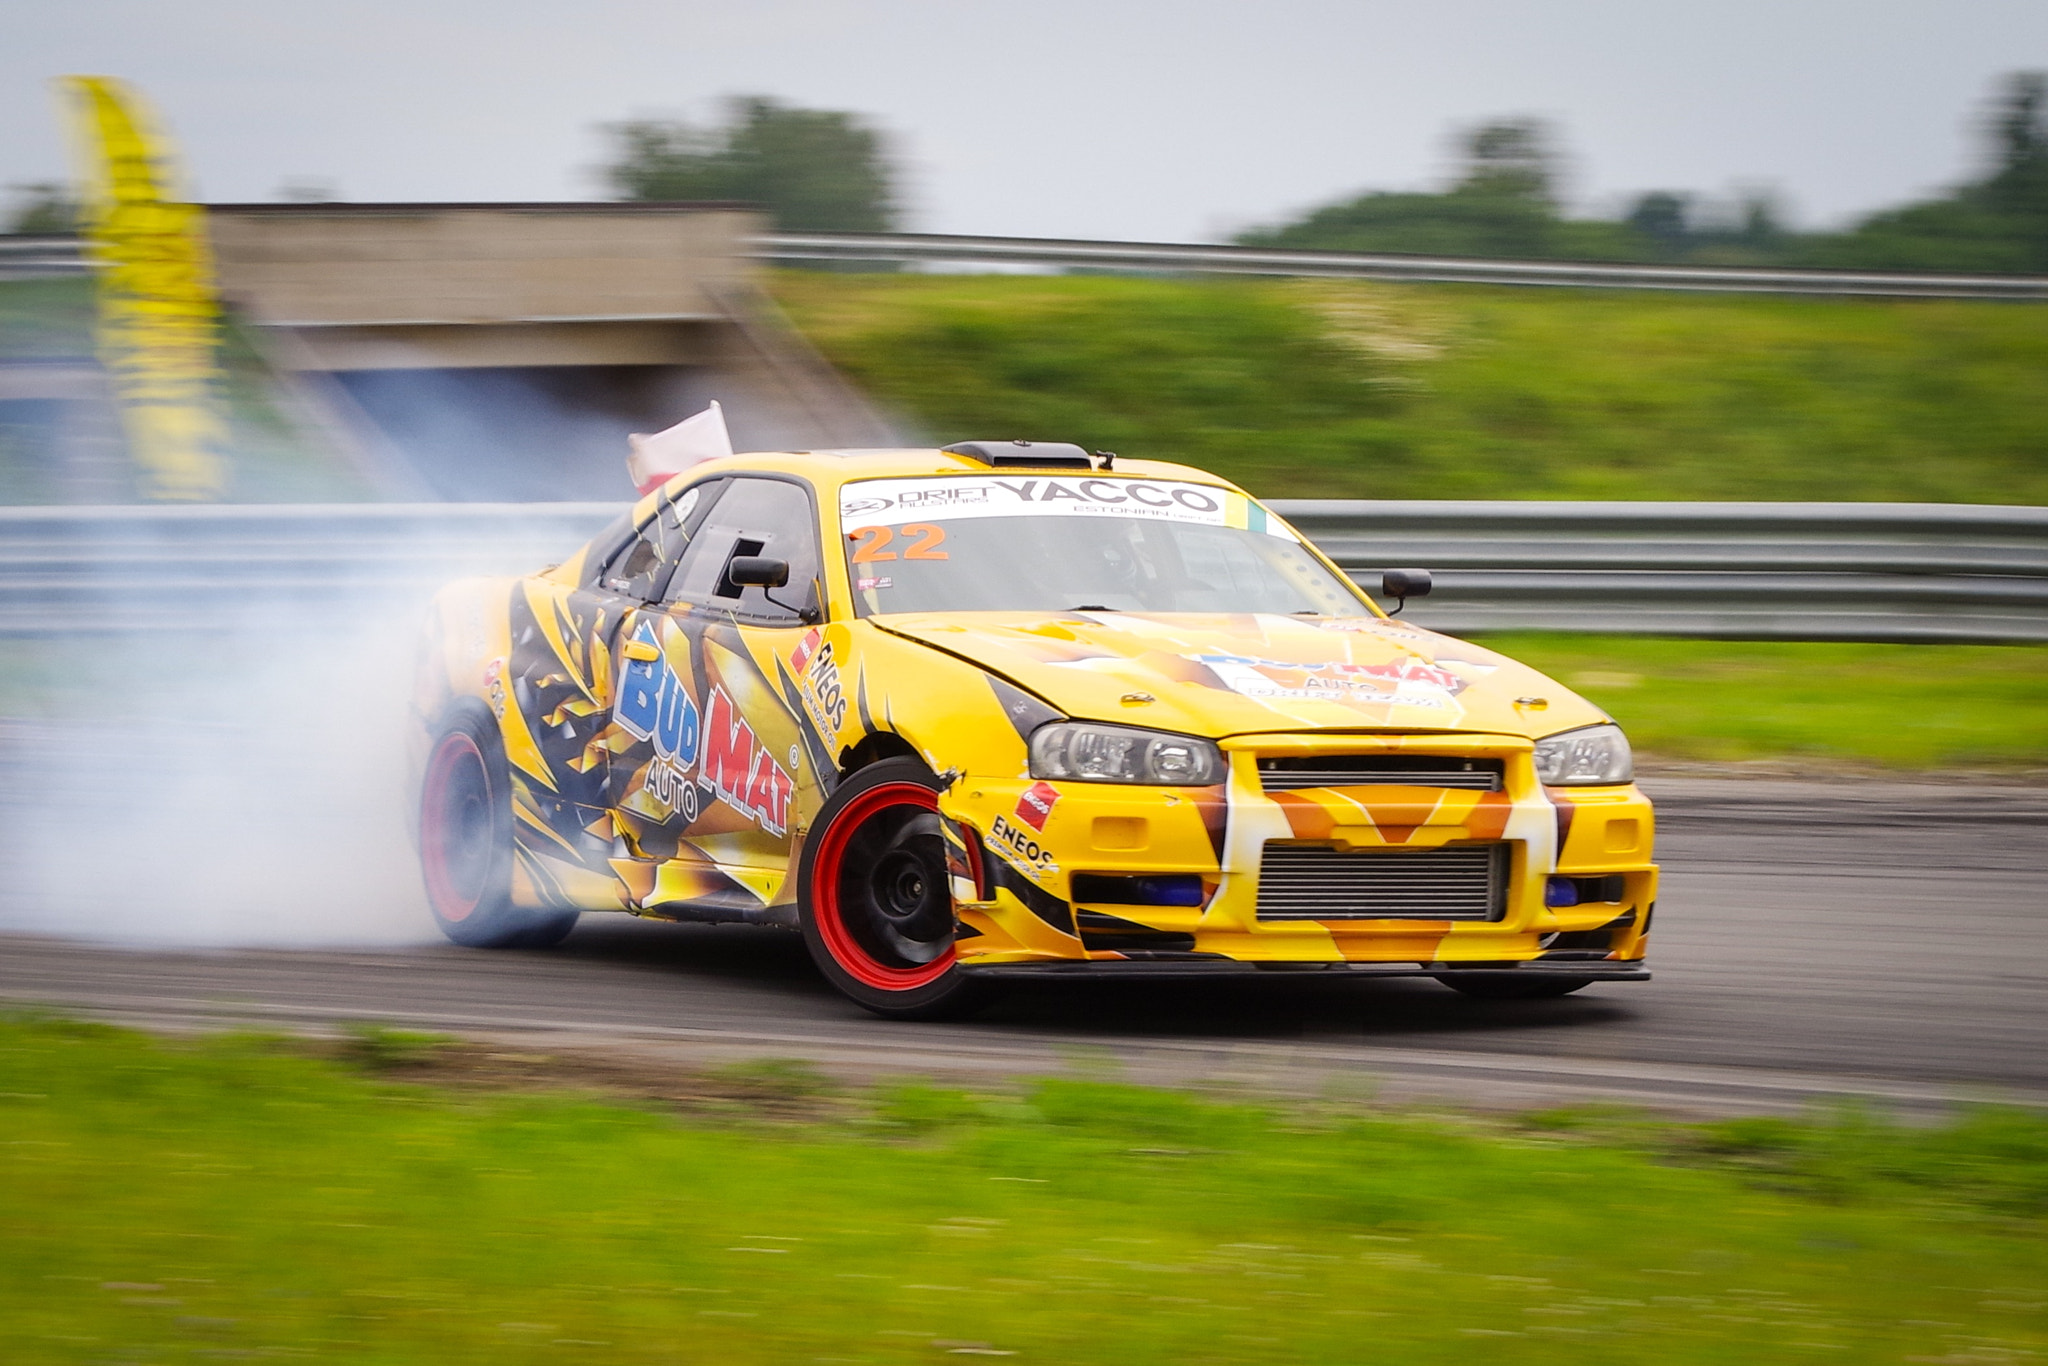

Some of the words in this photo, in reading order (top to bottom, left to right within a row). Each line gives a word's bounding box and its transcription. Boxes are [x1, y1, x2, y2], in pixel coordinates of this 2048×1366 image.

[898, 487, 996, 503] DRIFT
[991, 480, 1219, 512] YACCO
[1073, 505, 1169, 517] ESTONIAN
[851, 523, 949, 564] 22
[810, 642, 848, 732] ENEOS
[1304, 677, 1379, 692] AUTO
[644, 755, 698, 823] AUTO
[991, 814, 1054, 871] ENEOS
